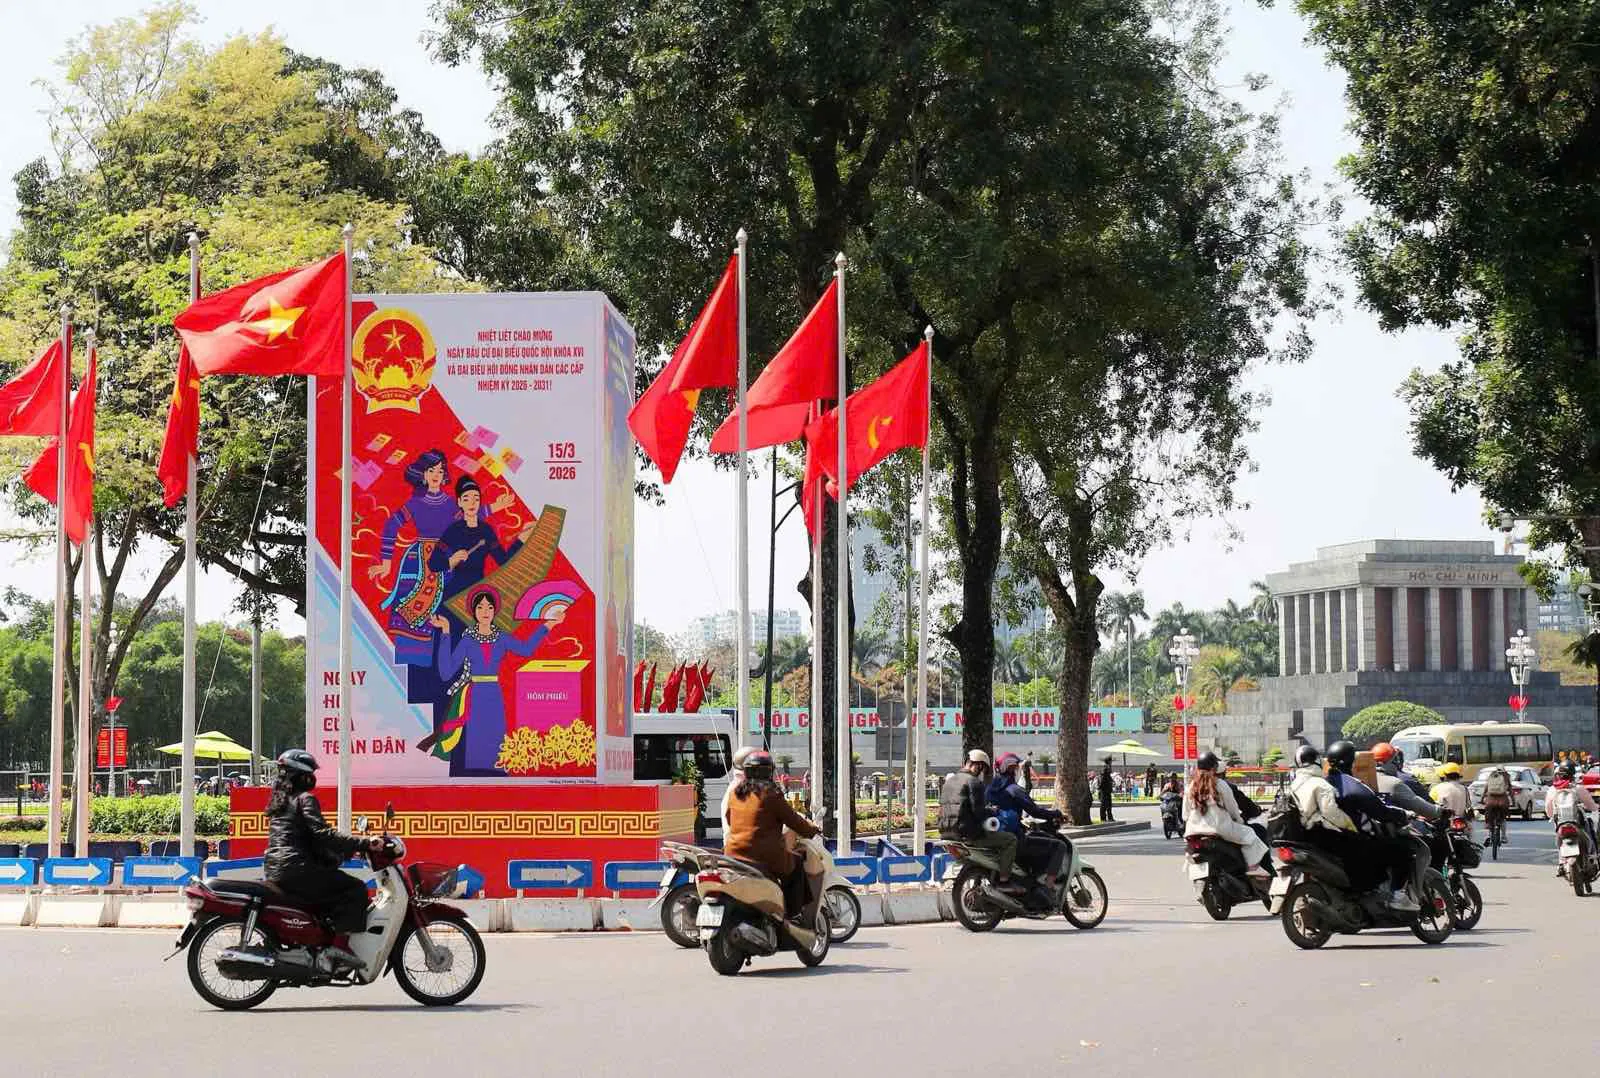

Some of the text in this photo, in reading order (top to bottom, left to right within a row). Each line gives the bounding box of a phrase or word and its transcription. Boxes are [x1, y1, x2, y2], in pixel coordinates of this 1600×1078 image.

[548, 442, 576, 459] 15/3
[549, 466, 576, 480] 2026
[1003, 710, 1055, 727] MUÔN
[372, 736, 406, 754] DÂN
